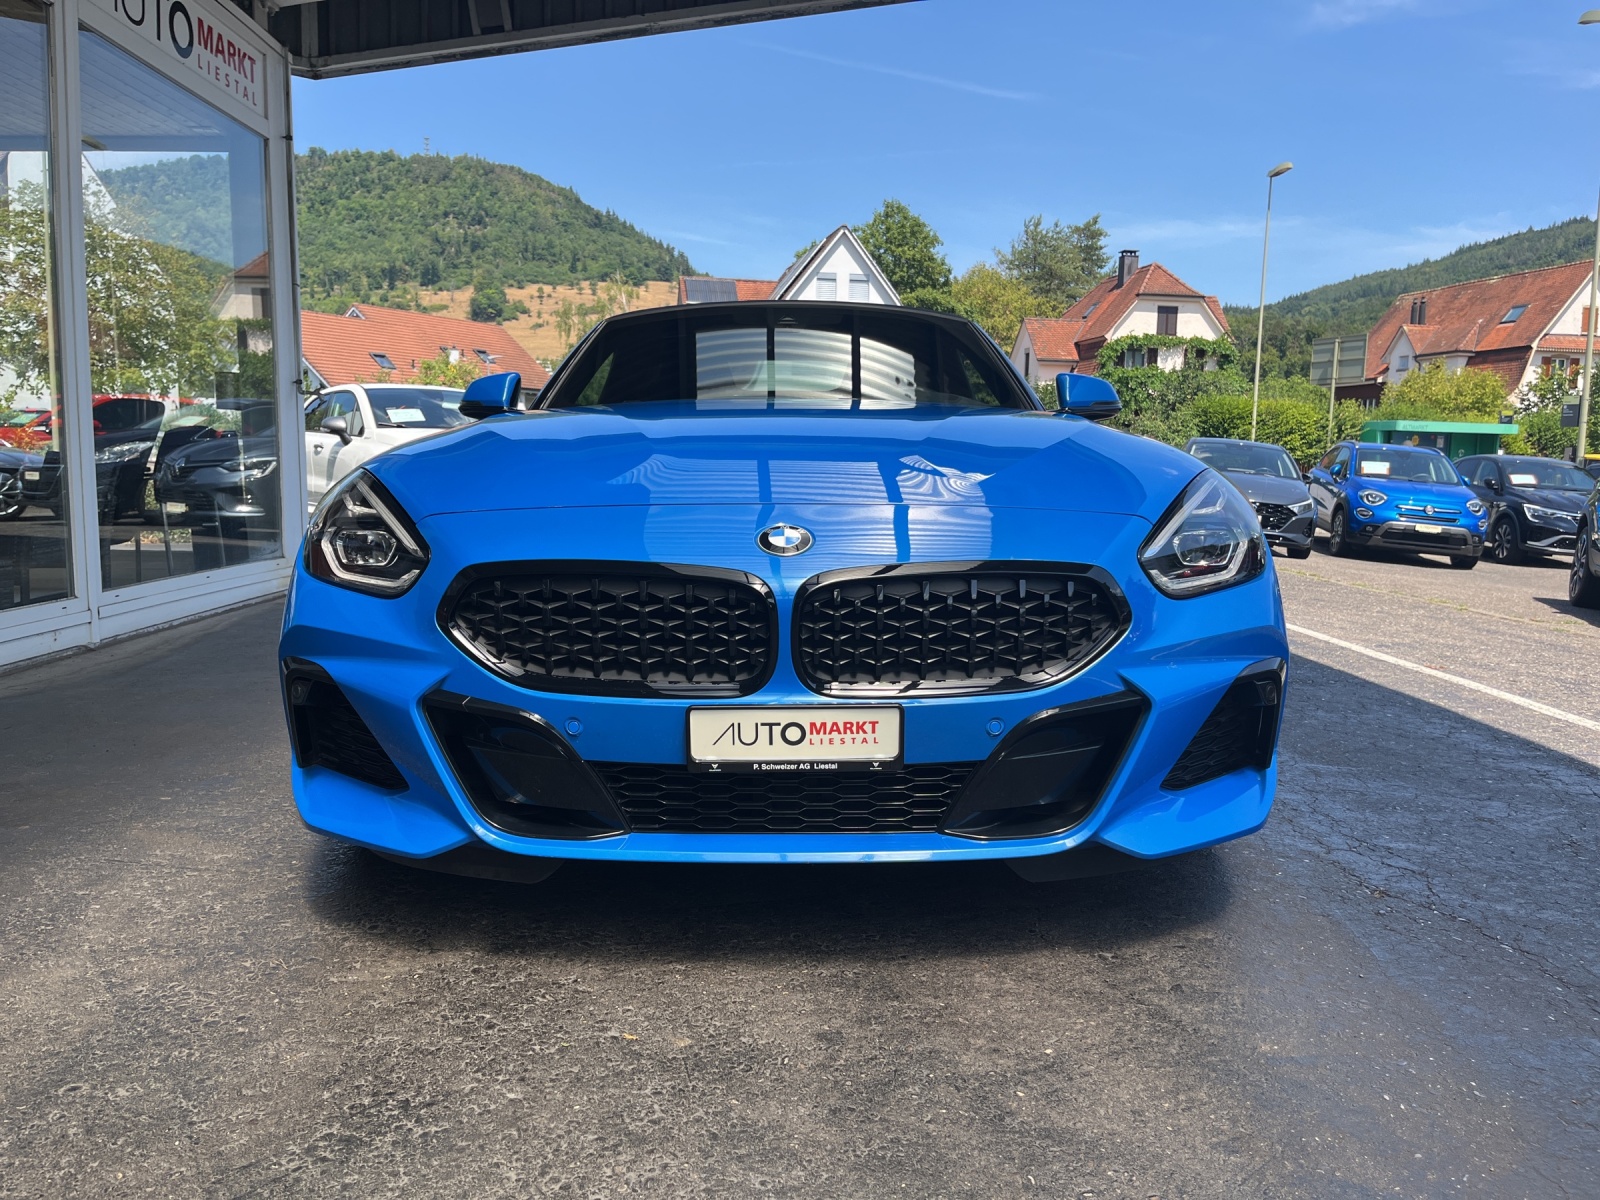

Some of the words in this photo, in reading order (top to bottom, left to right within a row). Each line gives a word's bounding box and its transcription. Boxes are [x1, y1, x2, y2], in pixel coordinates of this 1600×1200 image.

[197, 16, 256, 84] MARKT
[197, 53, 257, 106] LIESTAL
[712, 721, 806, 746] AUTO
[809, 720, 879, 735] MARKT
[809, 737, 879, 745] LIESTAL
